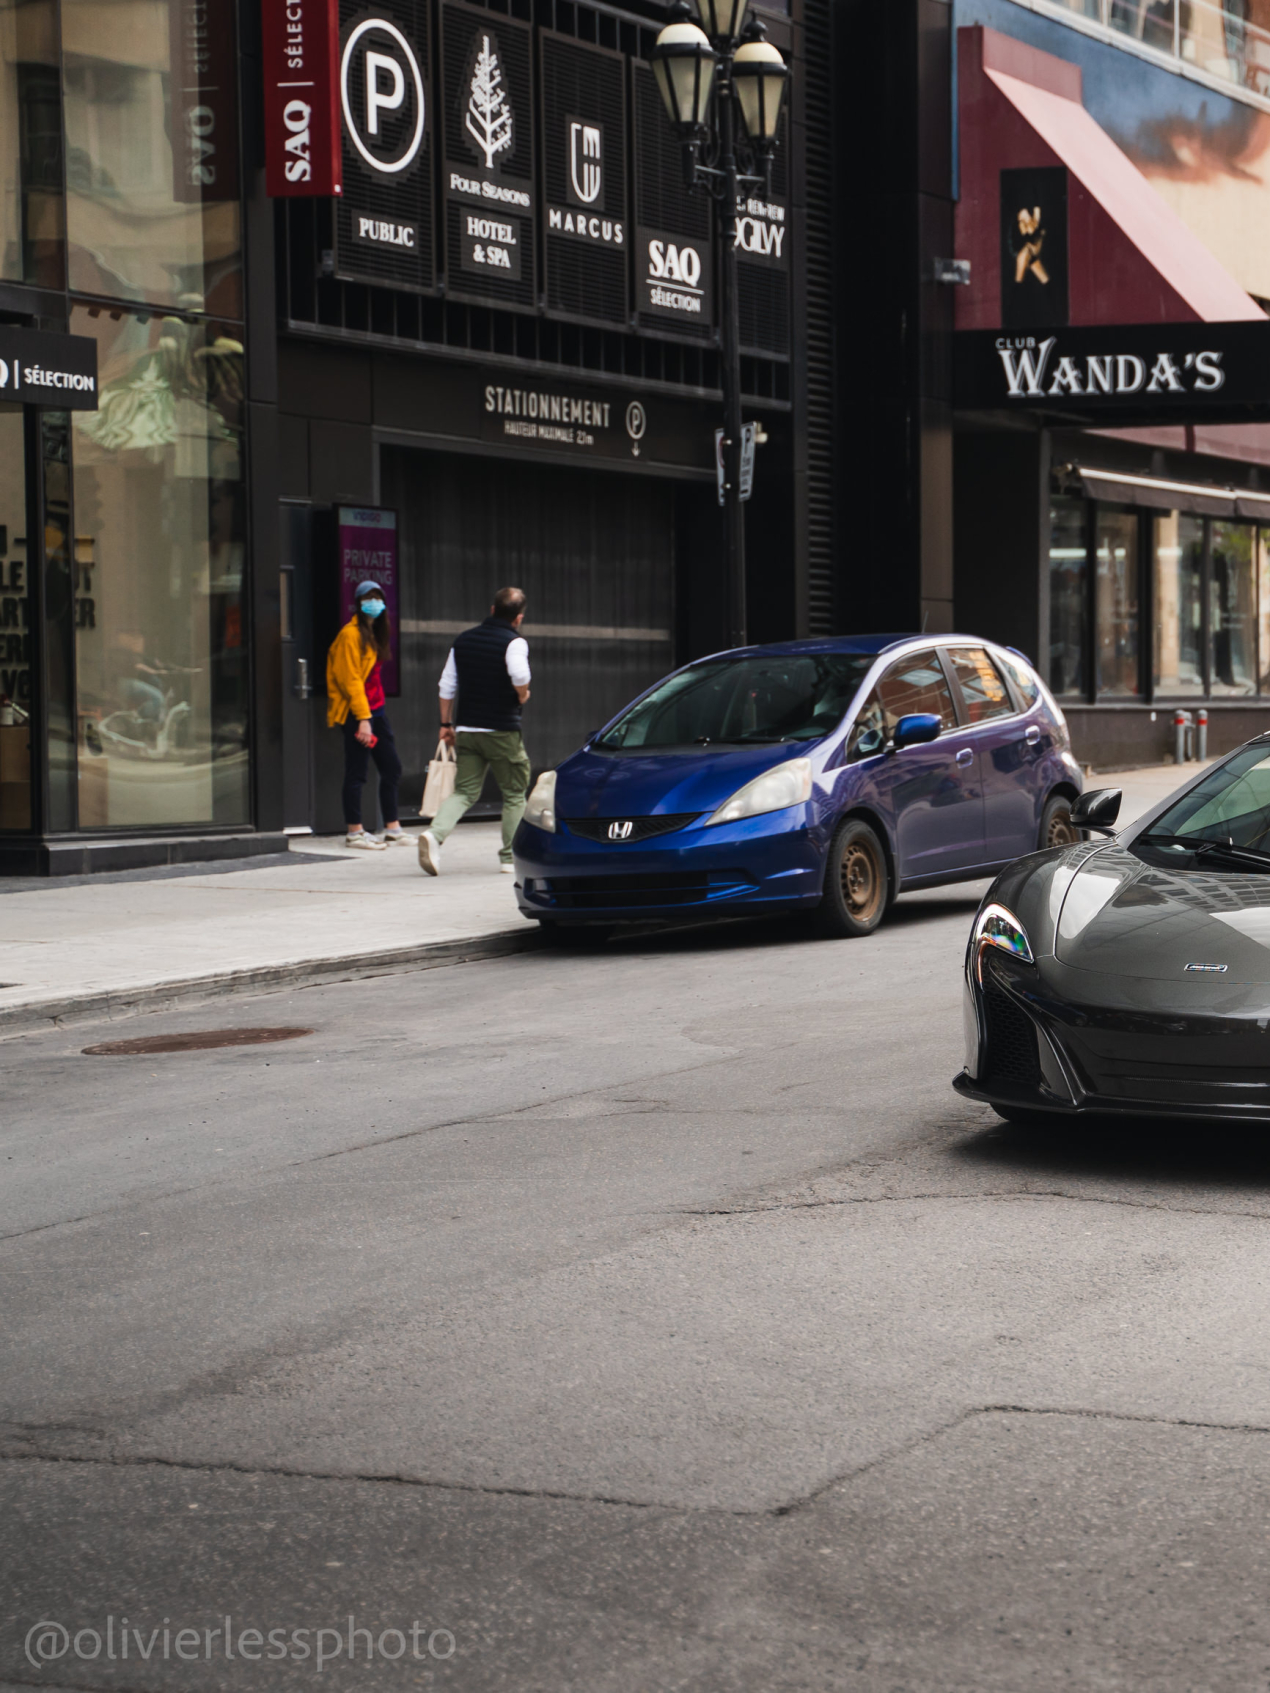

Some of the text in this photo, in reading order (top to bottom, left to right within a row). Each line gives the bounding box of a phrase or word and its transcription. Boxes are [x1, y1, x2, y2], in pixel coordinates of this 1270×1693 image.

[365, 51, 404, 135] P
[283, 100, 311, 182] SAQ
[450, 173, 531, 207] FOUR SEASONS
[358, 217, 414, 247] PUBLIC
[466, 215, 517, 245] HOTEL
[549, 208, 623, 244] MARCUS
[472, 243, 512, 269] & SPA
[649, 239, 701, 287] SAQ
[650, 286, 701, 313] SÉLECTION
[995, 336, 1035, 349] CLUB
[24, 365, 94, 391] SÉLECTION
[998, 336, 1225, 398] WANDA'S
[485, 385, 610, 428] STATIONNEMENT
[343, 549, 392, 568] PRIVATE
[343, 568, 393, 585] PARKING
